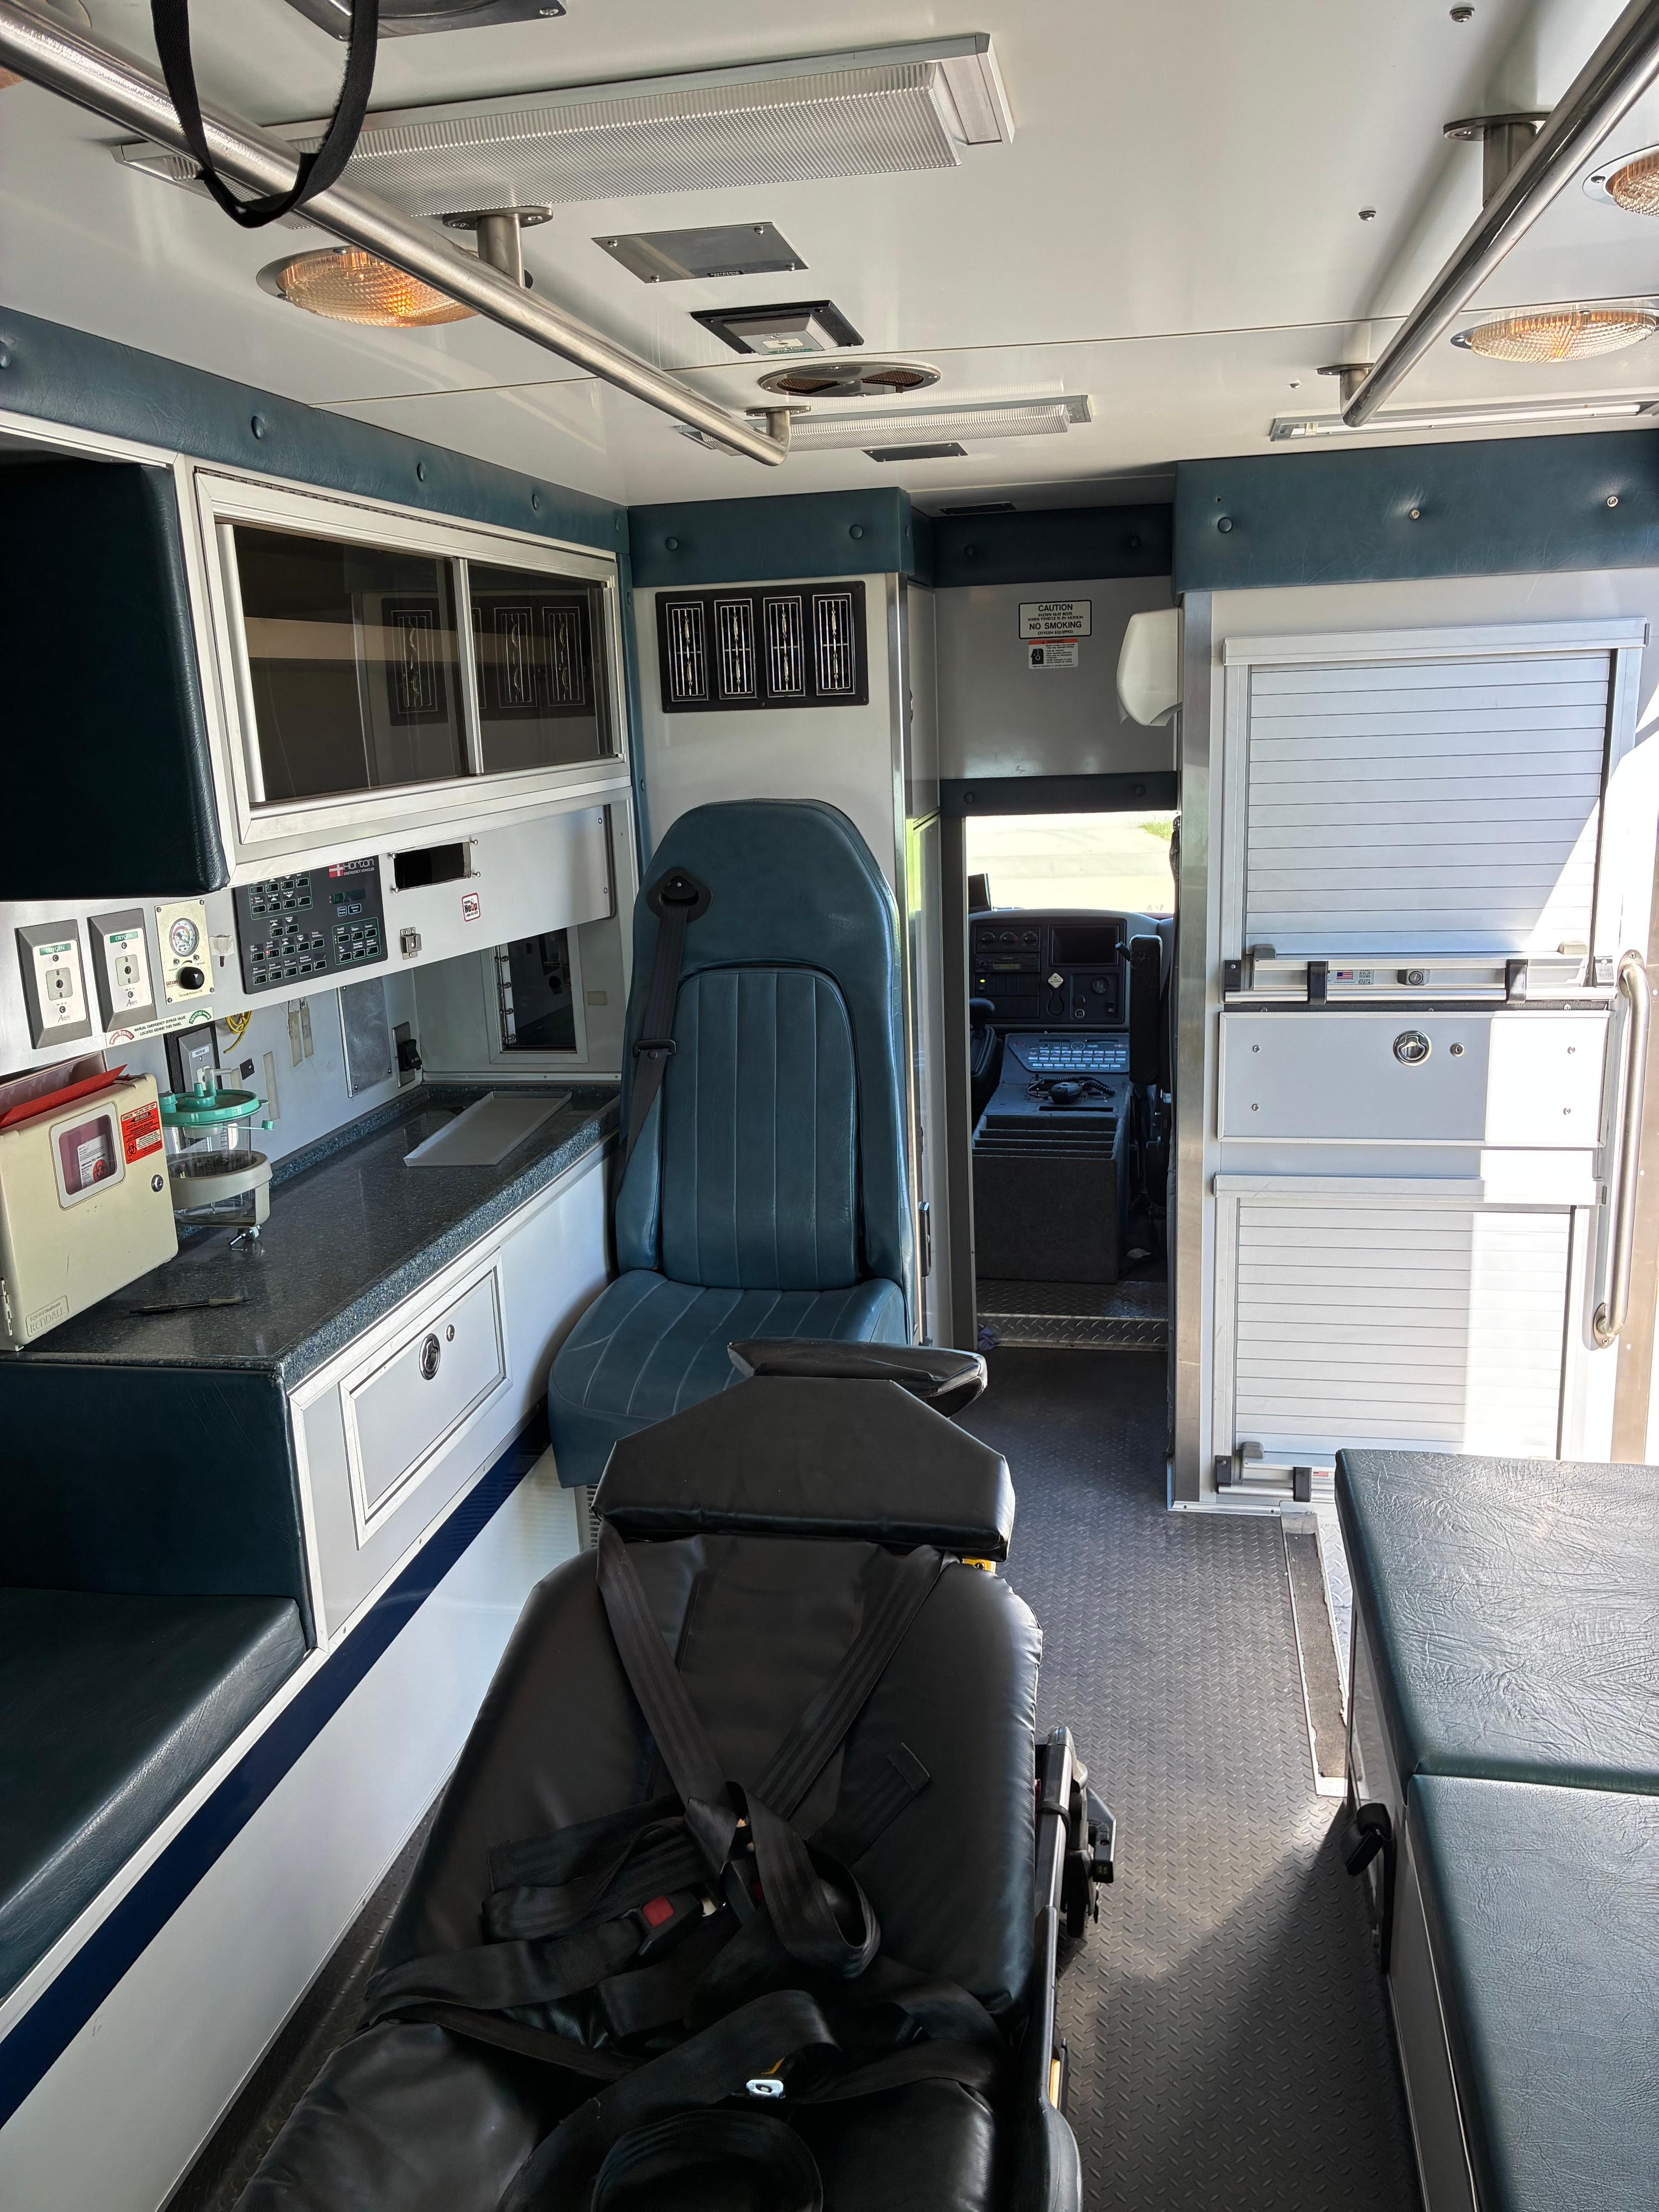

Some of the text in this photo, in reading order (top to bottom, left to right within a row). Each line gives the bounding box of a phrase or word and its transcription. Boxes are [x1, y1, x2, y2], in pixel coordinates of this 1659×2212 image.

[1045, 621, 1082, 629] SMOKING
[343, 859, 374, 870] Horton
[190, 1010, 203, 1022] Normal
[30, 1307, 66, 1333] KENDALL
